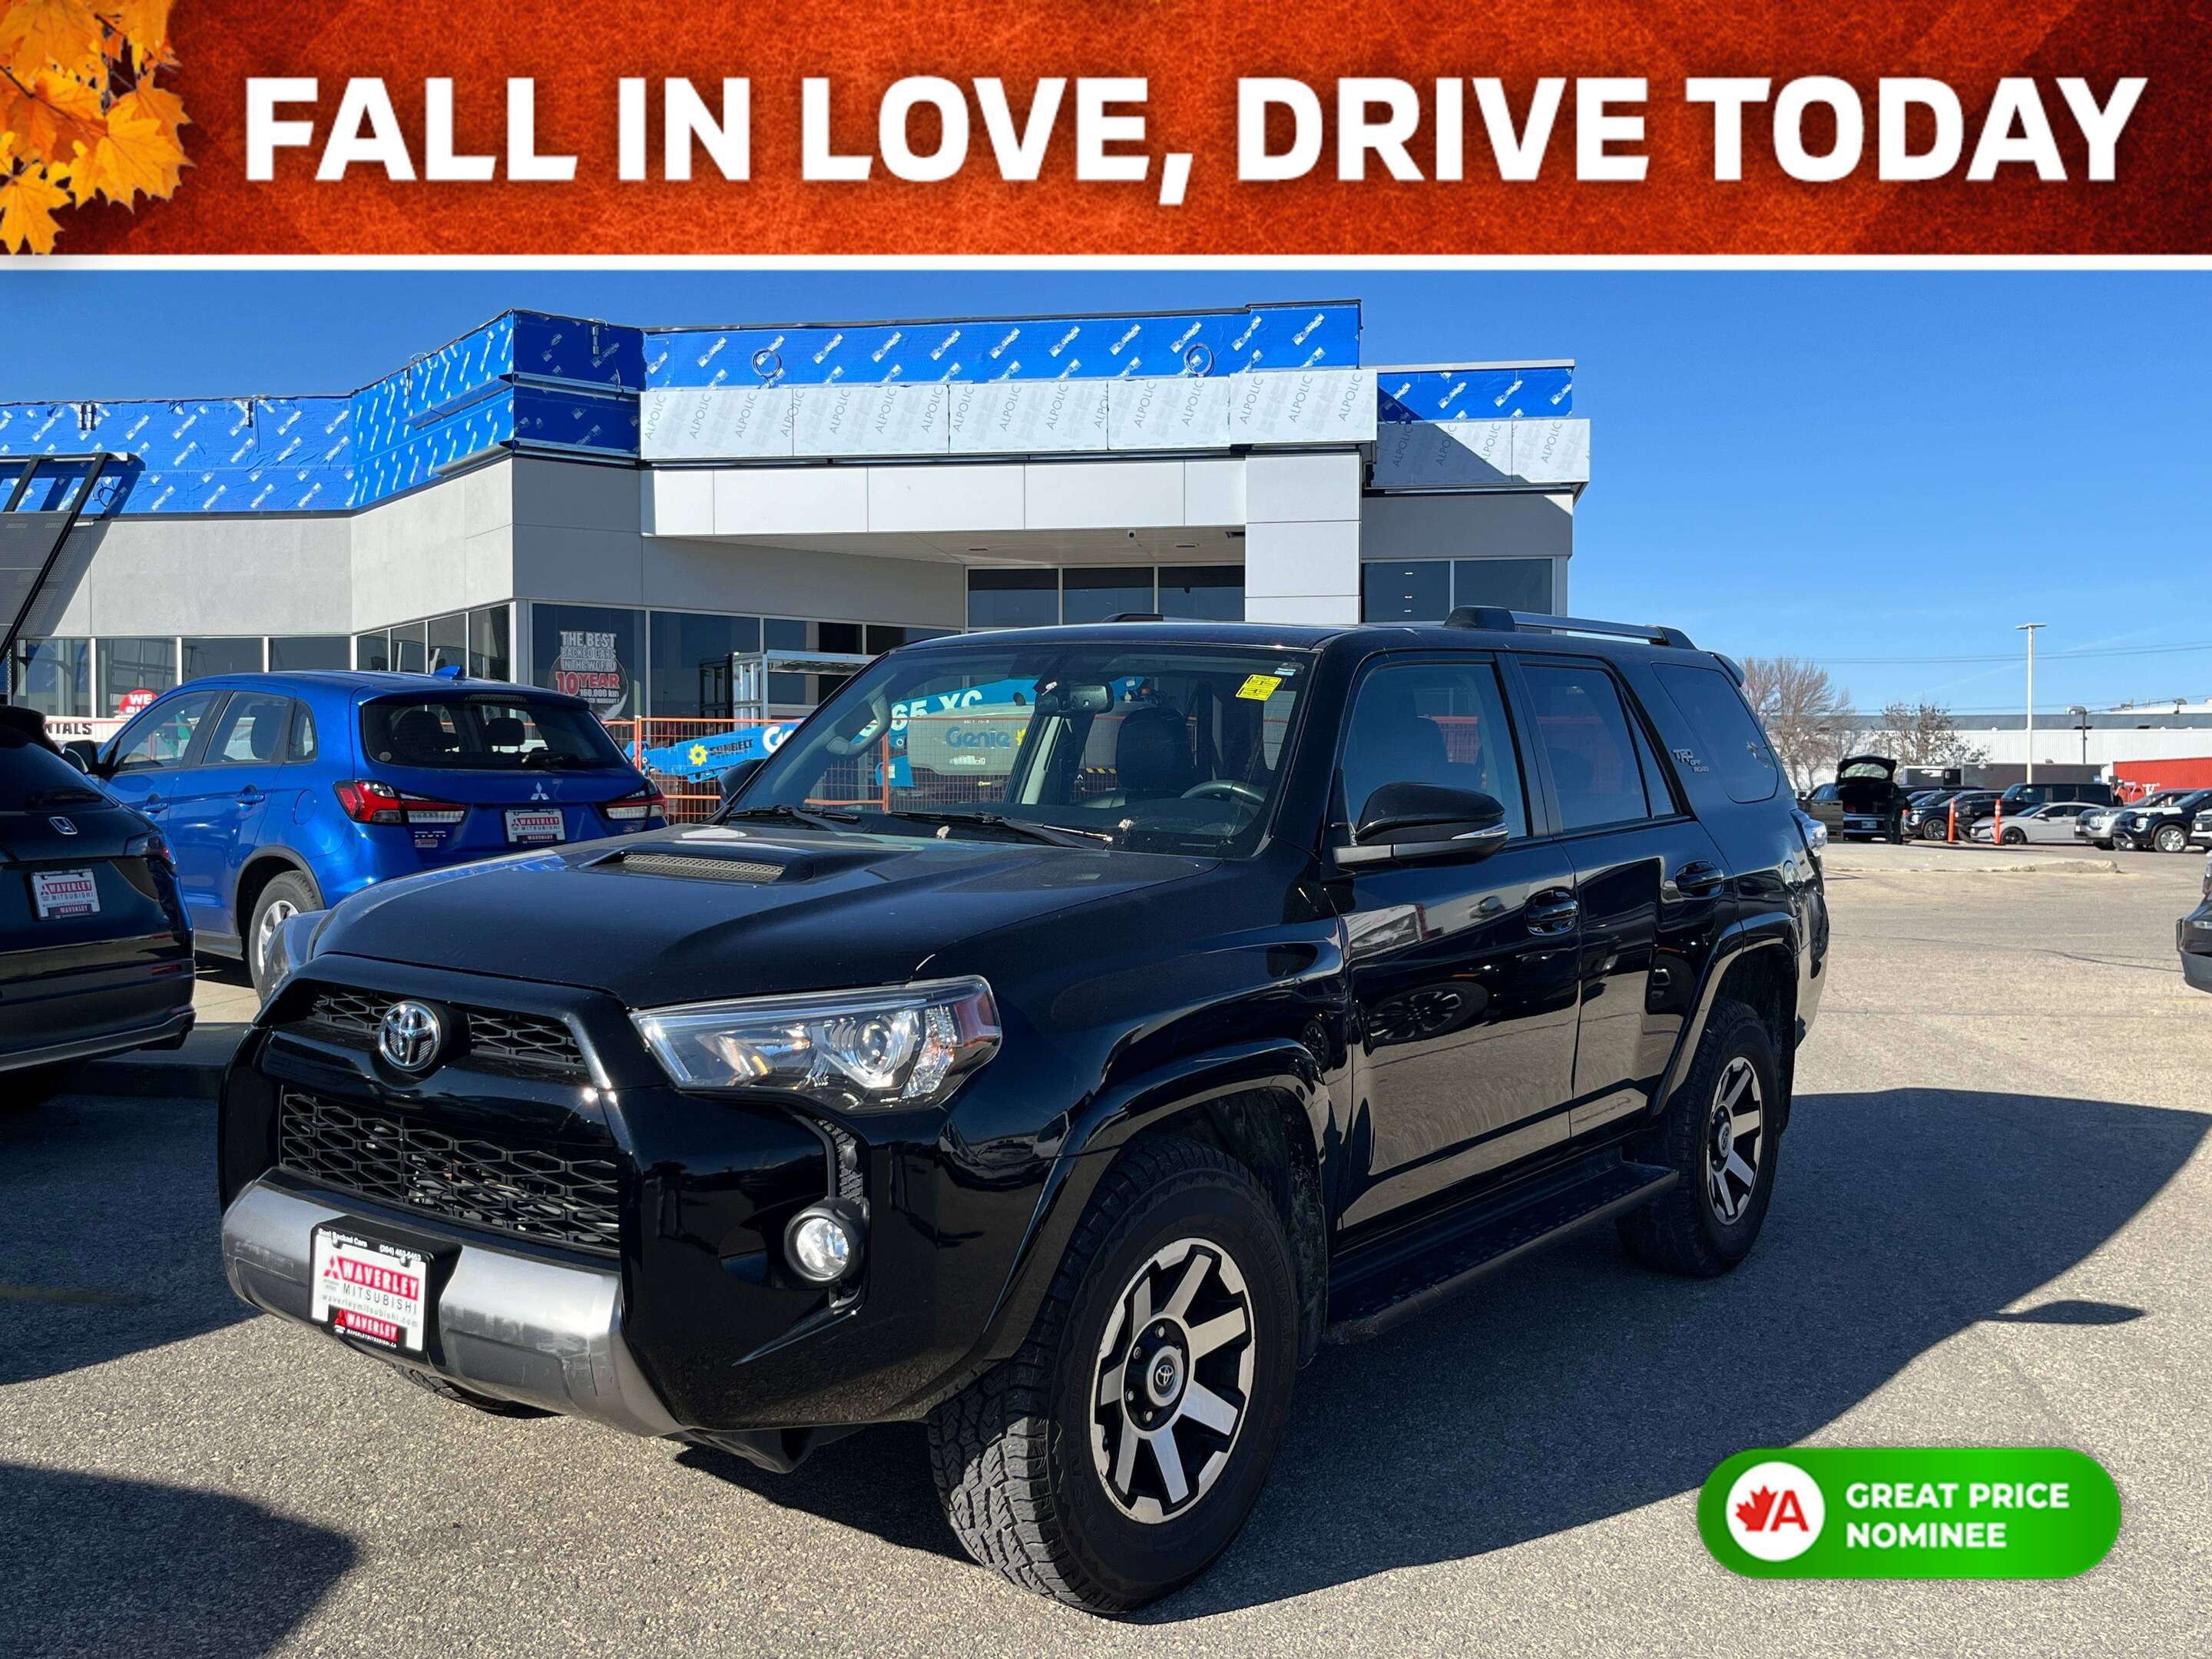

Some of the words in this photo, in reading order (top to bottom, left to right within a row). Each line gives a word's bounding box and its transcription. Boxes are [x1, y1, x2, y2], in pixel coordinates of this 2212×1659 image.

[644, 392, 667, 441] ALPOLIC
[689, 391, 713, 440] ALPOLIC
[735, 390, 758, 439] ALPOLIC
[780, 389, 806, 438] ALPOLIC
[829, 389, 852, 435] ALPOLIC
[875, 387, 898, 435] ALPOLIC
[922, 386, 944, 434] ALPOLIC
[952, 384, 975, 433] ALPOLIC
[998, 384, 1022, 432] ALPOLIC
[1045, 383, 1069, 430] ALPOLIC
[1134, 380, 1157, 429] ALPOLIC
[1181, 379, 1205, 427] ALPOLIC
[1239, 376, 1265, 425] ALPOLIC
[1288, 375, 1314, 423] ALPOLIC
[1337, 373, 1363, 422] ALPOLIC
[1392, 424, 1414, 468] ALPOLIC
[1540, 421, 1563, 464] ALPOLIC
[560, 631, 584, 647] THE
[585, 631, 617, 647] BEST
[128, 694, 153, 704] WE
[555, 671, 579, 697] 10
[578, 673, 620, 689] YEAR
[891, 700, 929, 730] 65
[945, 726, 1011, 750] Genie
[48, 882, 91, 892] WAVERLEY
[343, 1260, 418, 1298] WAVERLEY
[343, 1283, 417, 1315] MITSUBISHI
[347, 1313, 397, 1339] WAVERLEY
